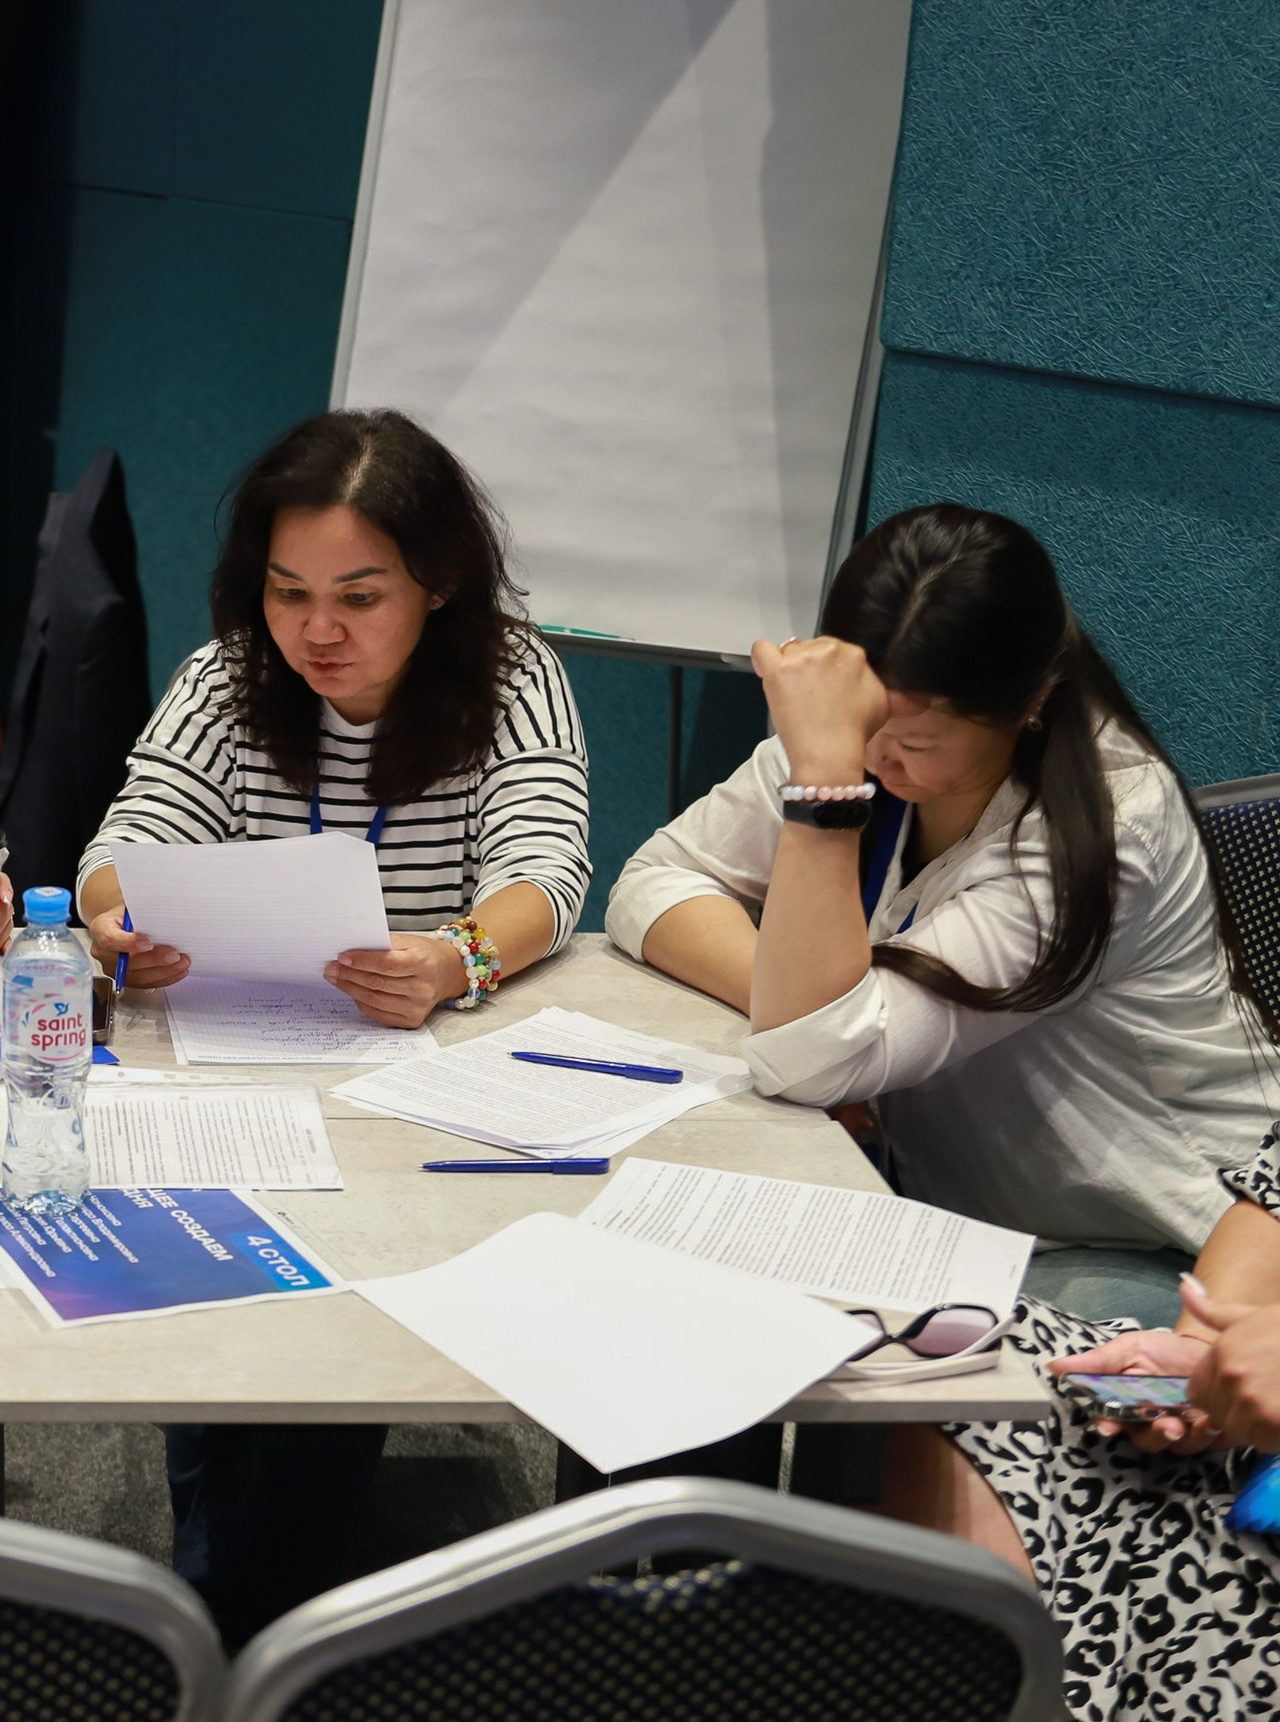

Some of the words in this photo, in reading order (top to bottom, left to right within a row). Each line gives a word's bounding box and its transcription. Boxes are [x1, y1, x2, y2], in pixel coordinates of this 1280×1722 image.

[37, 1012, 84, 1032] saint
[31, 1029, 87, 1052] spring
[170, 1209, 234, 1261] СОЗДАЕМ
[247, 1235, 273, 1247] 4
